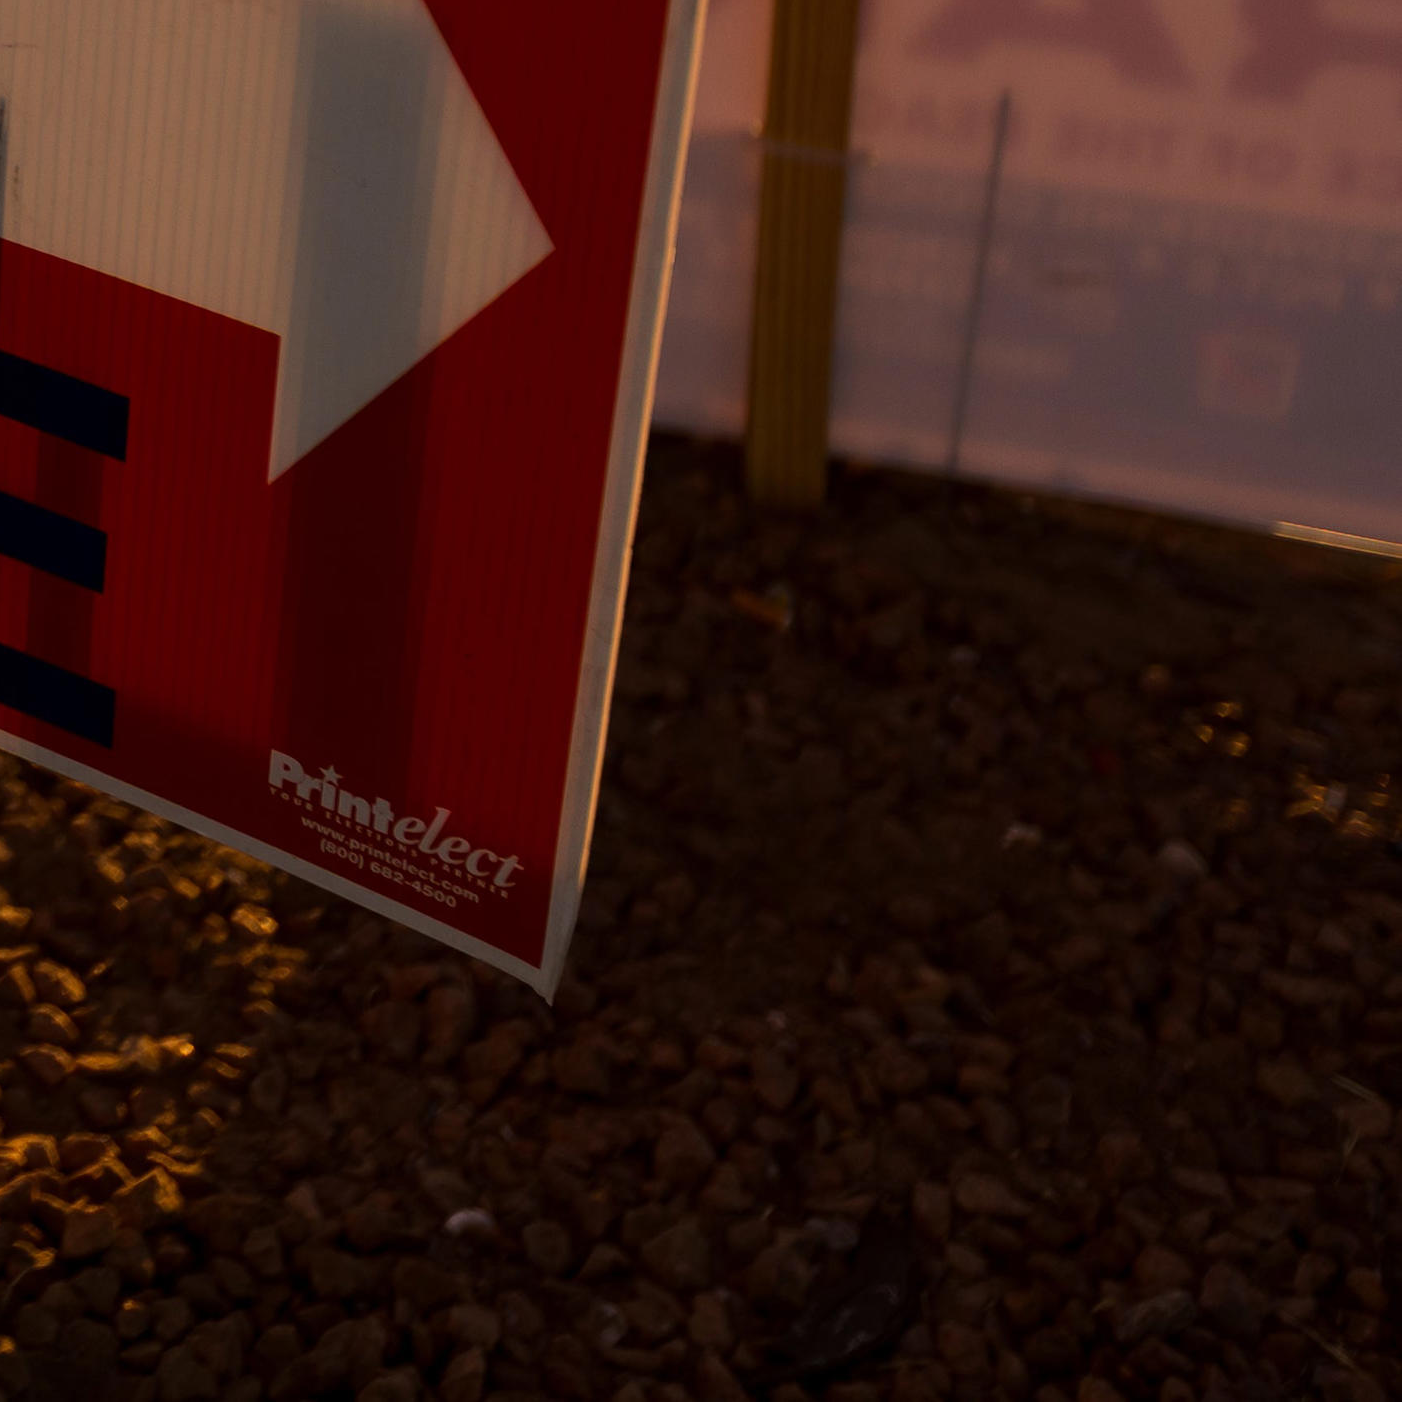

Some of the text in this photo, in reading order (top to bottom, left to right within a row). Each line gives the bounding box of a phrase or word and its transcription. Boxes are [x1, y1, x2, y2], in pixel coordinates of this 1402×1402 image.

[268, 749, 524, 888] Printelect
[300, 816, 480, 904] www.printelect.com
[319, 838, 458, 909] (800) 682-4500
